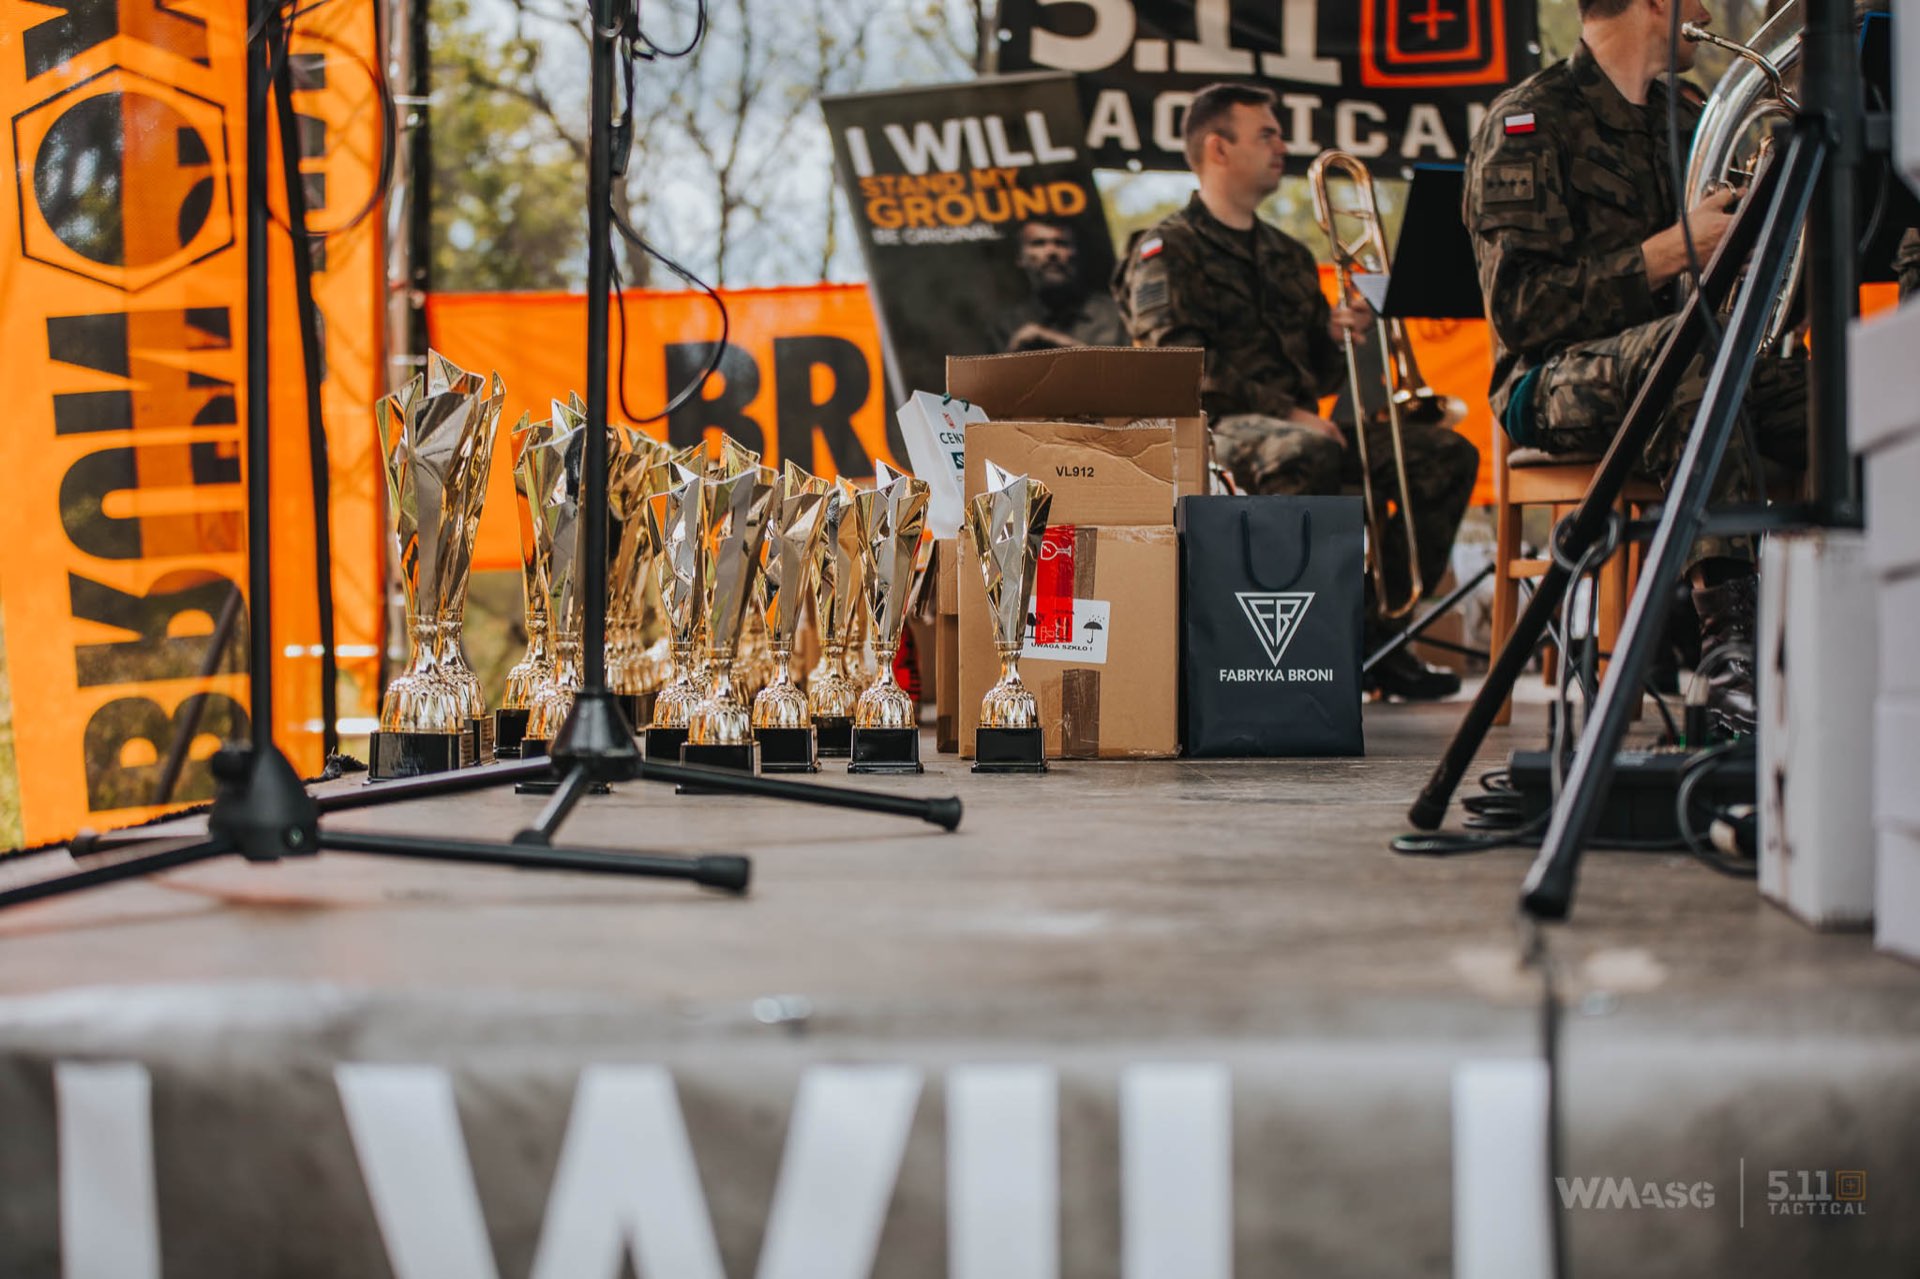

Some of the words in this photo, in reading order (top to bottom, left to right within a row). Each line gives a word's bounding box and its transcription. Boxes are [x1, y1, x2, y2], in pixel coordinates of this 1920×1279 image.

[845, 126, 875, 177] I
[884, 110, 1078, 176] WILL
[1086, 88, 1488, 159] ACICA
[858, 172, 966, 199] STAND
[970, 166, 1020, 191] MY
[866, 181, 1088, 229] GROUND
[664, 335, 914, 480] BR
[1055, 465, 1094, 479] VL912
[1219, 669, 1285, 682] FABRYKA
[1288, 669, 1333, 682] BRONI
